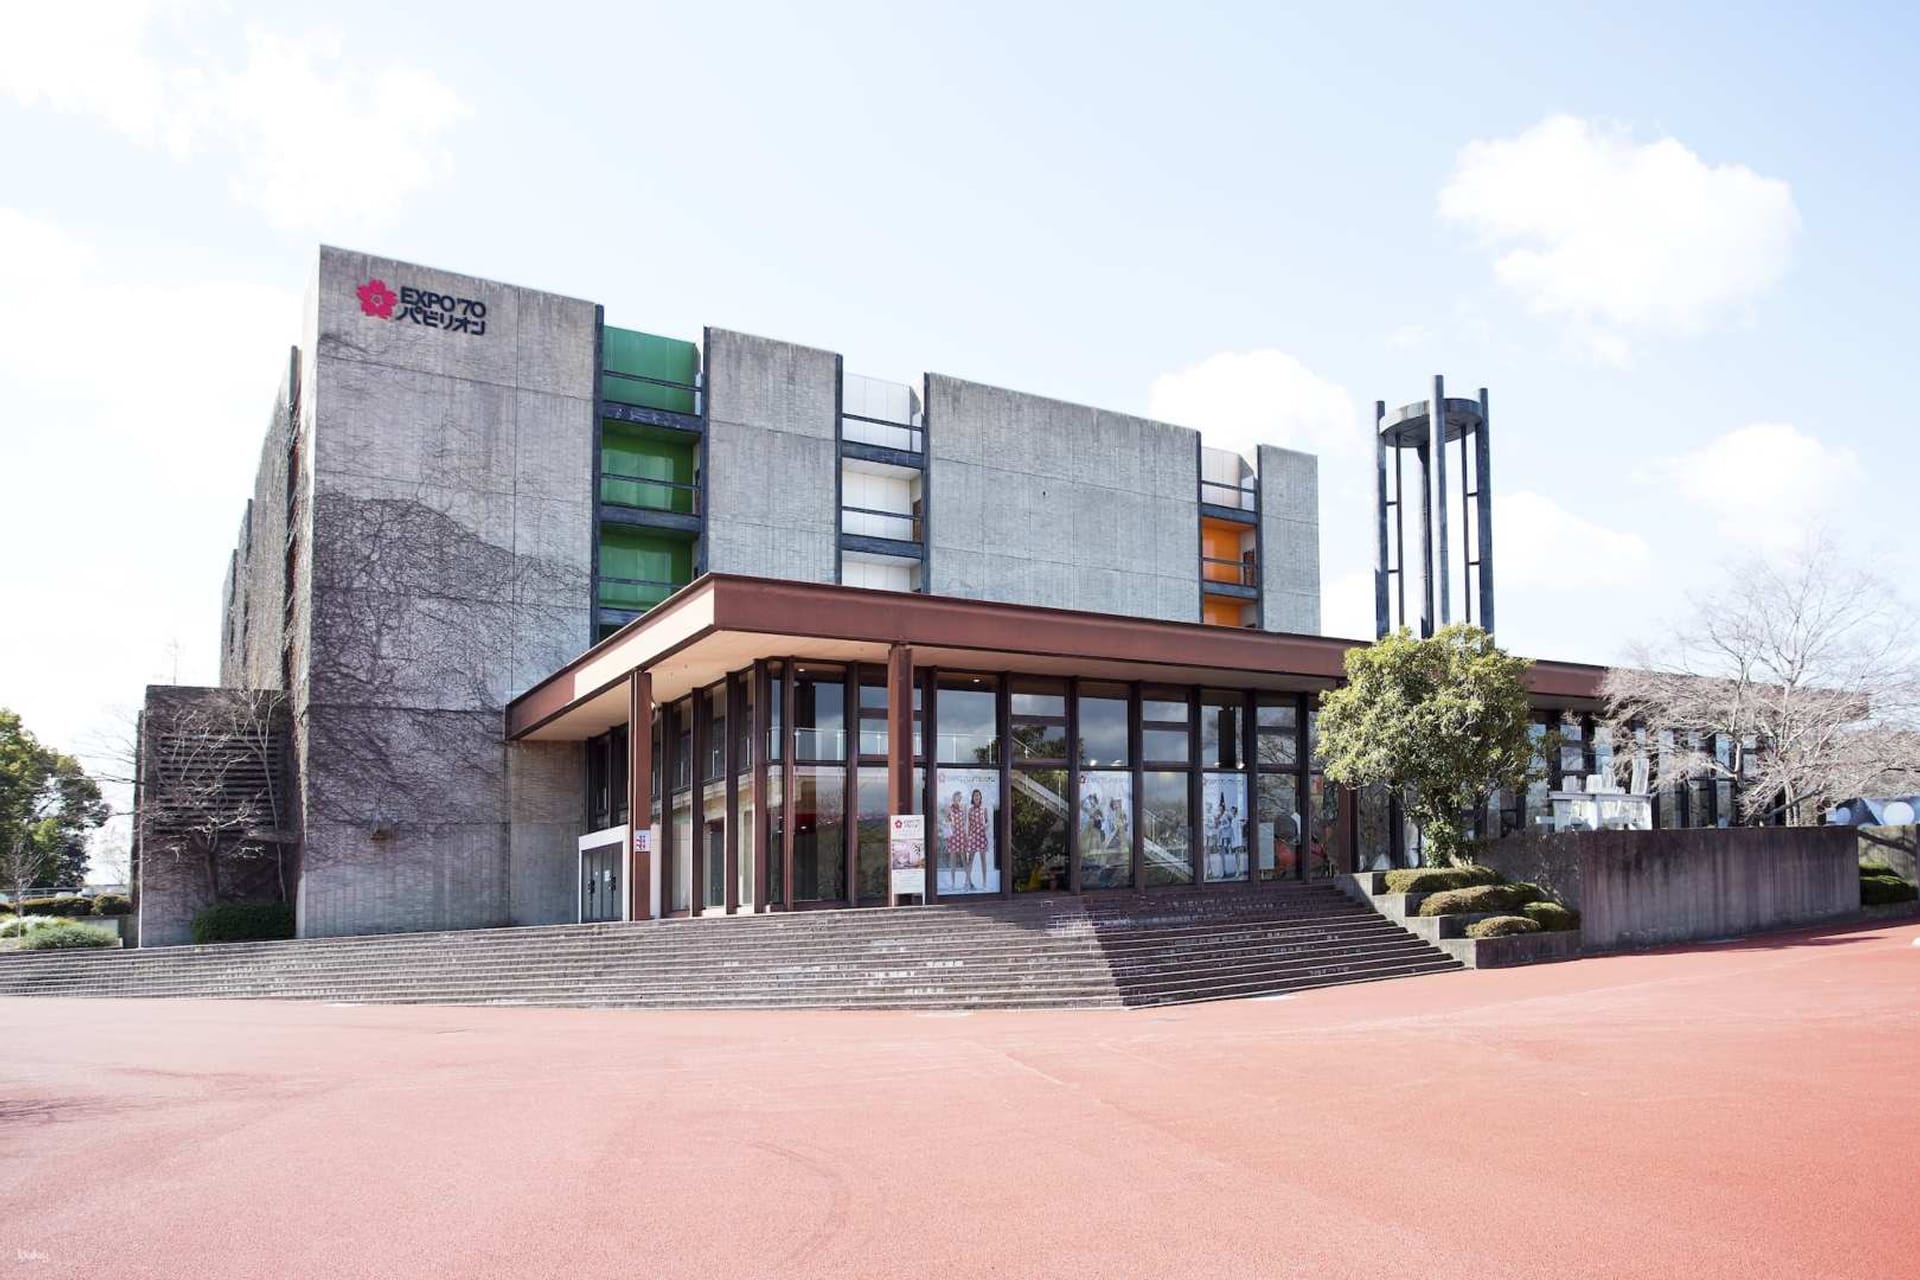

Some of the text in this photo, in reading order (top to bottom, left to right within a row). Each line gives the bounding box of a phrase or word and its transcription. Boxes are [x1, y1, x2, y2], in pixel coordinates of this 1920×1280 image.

[395, 305, 486, 336] パビリオン
